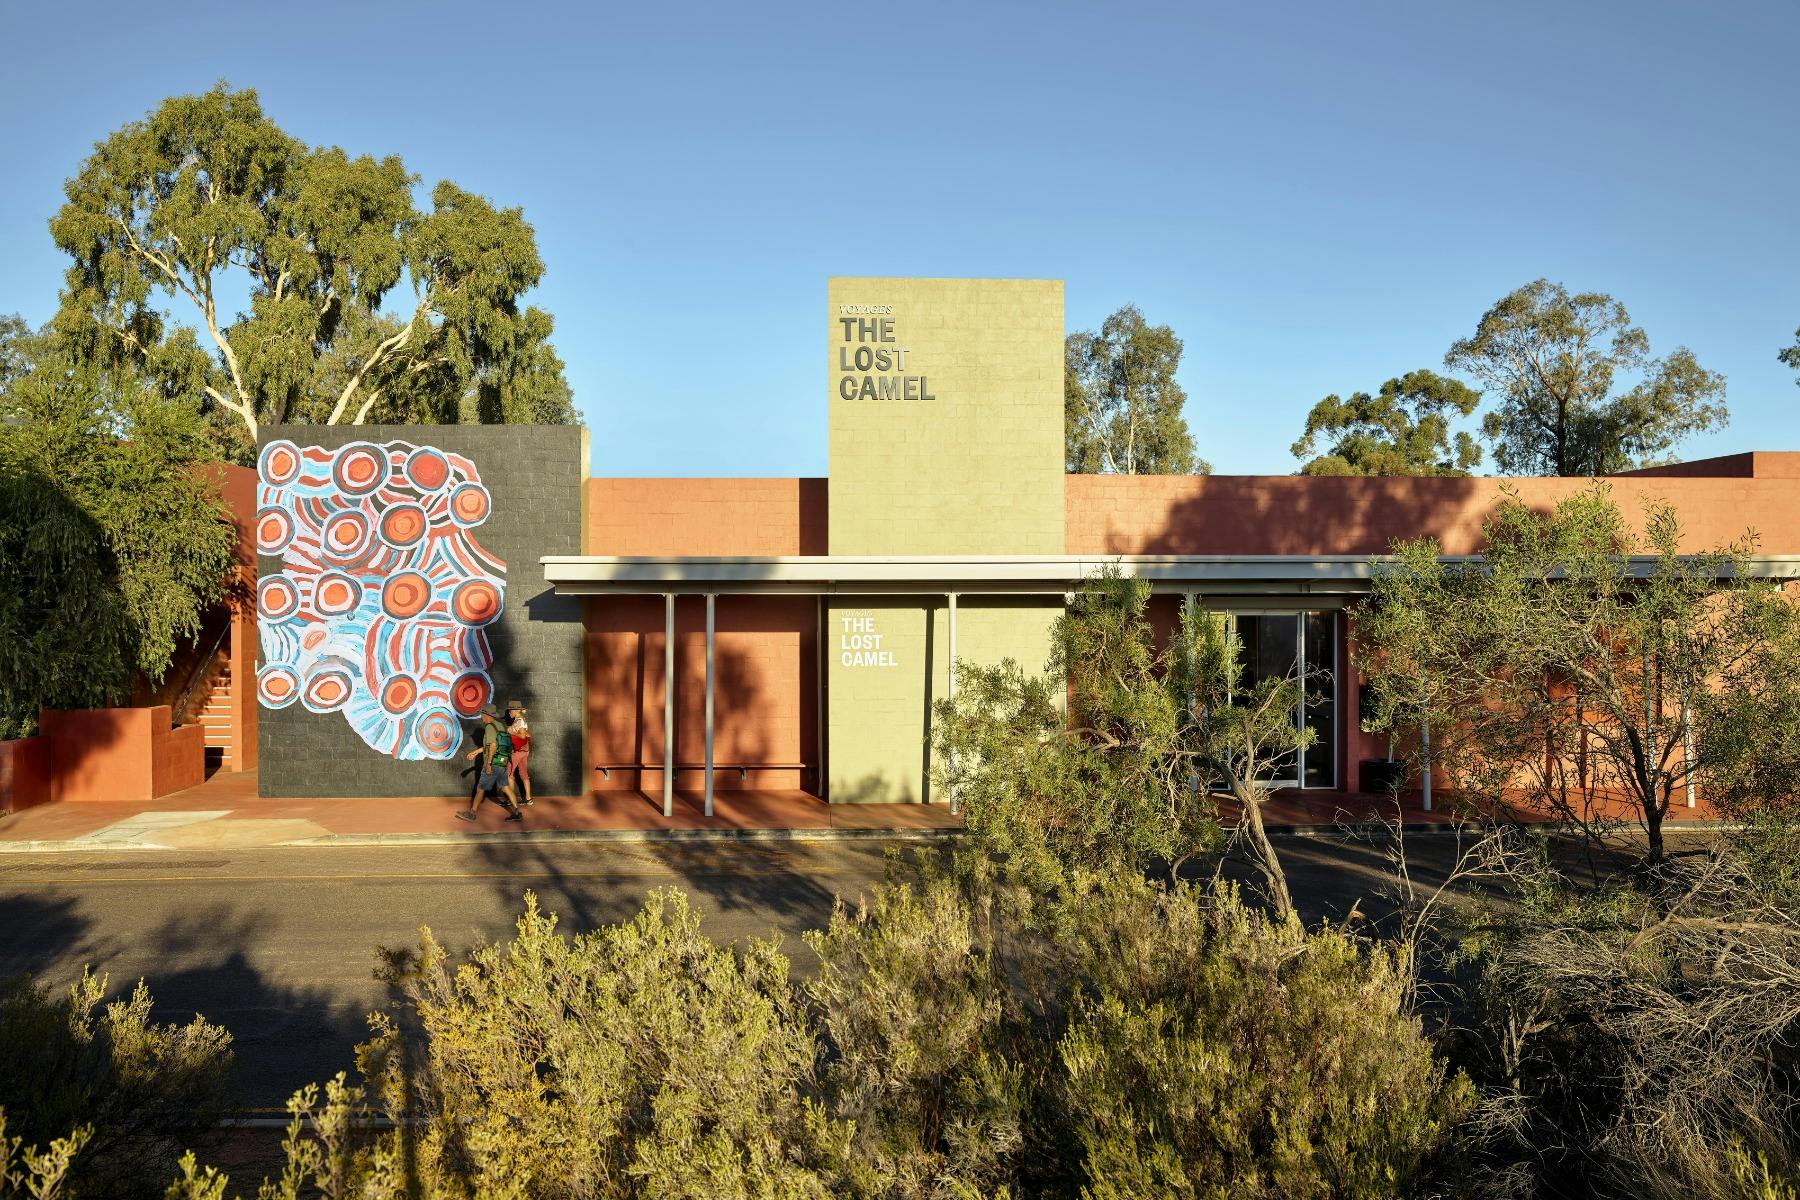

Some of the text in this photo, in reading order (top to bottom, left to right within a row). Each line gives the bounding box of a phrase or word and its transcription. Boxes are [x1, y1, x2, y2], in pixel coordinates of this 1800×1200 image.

[840, 304, 893, 315] VOYAGES
[839, 317, 896, 342] THE
[839, 345, 910, 372] LOST
[839, 375, 936, 401] CAMEL
[841, 617, 875, 633] THE
[841, 634, 883, 650] LOST
[841, 651, 898, 667] CAMEL
